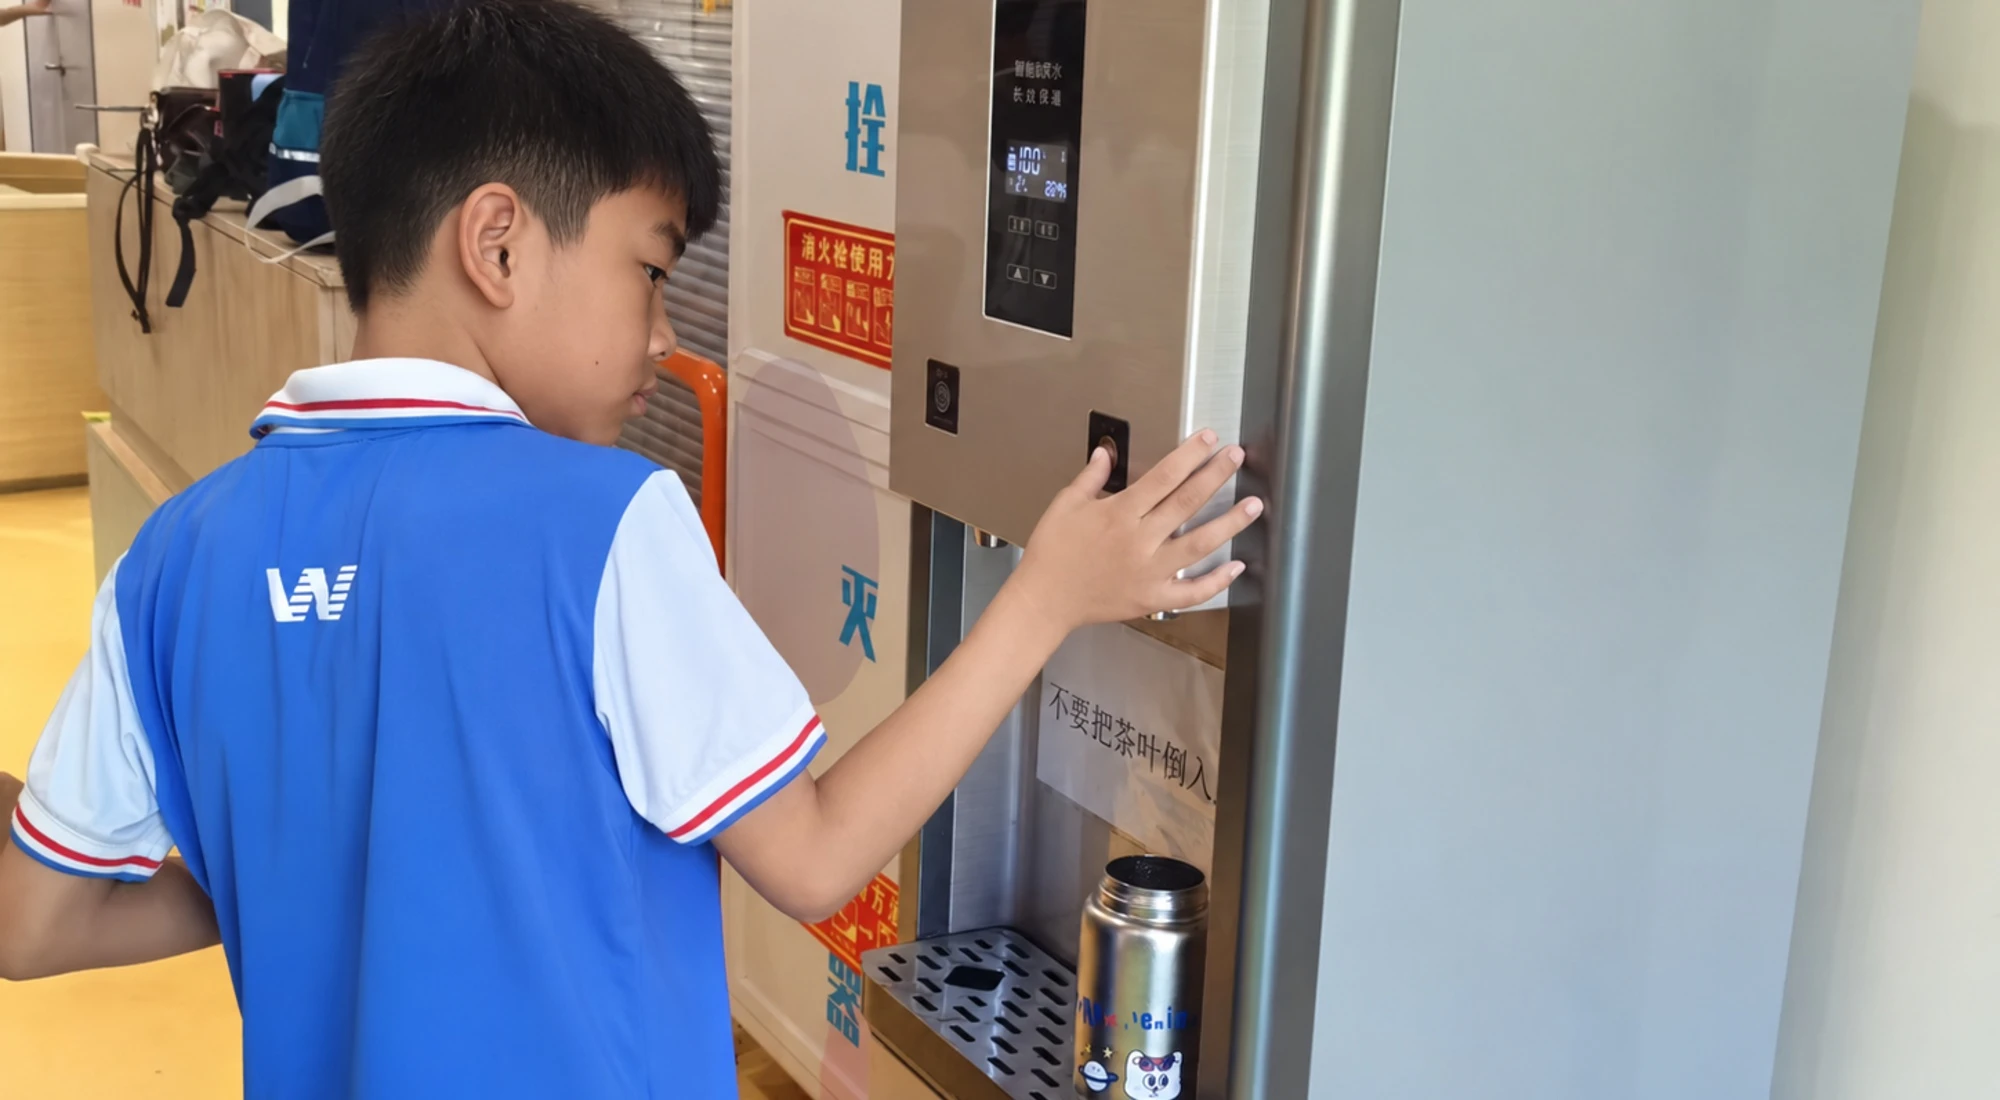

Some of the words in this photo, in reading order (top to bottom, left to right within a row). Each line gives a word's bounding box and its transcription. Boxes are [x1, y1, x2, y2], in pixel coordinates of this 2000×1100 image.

[1019, 146, 1041, 175] 100
[839, 564, 878, 663] 灭
[1049, 682, 1217, 805] 不要把茶叶倒入
